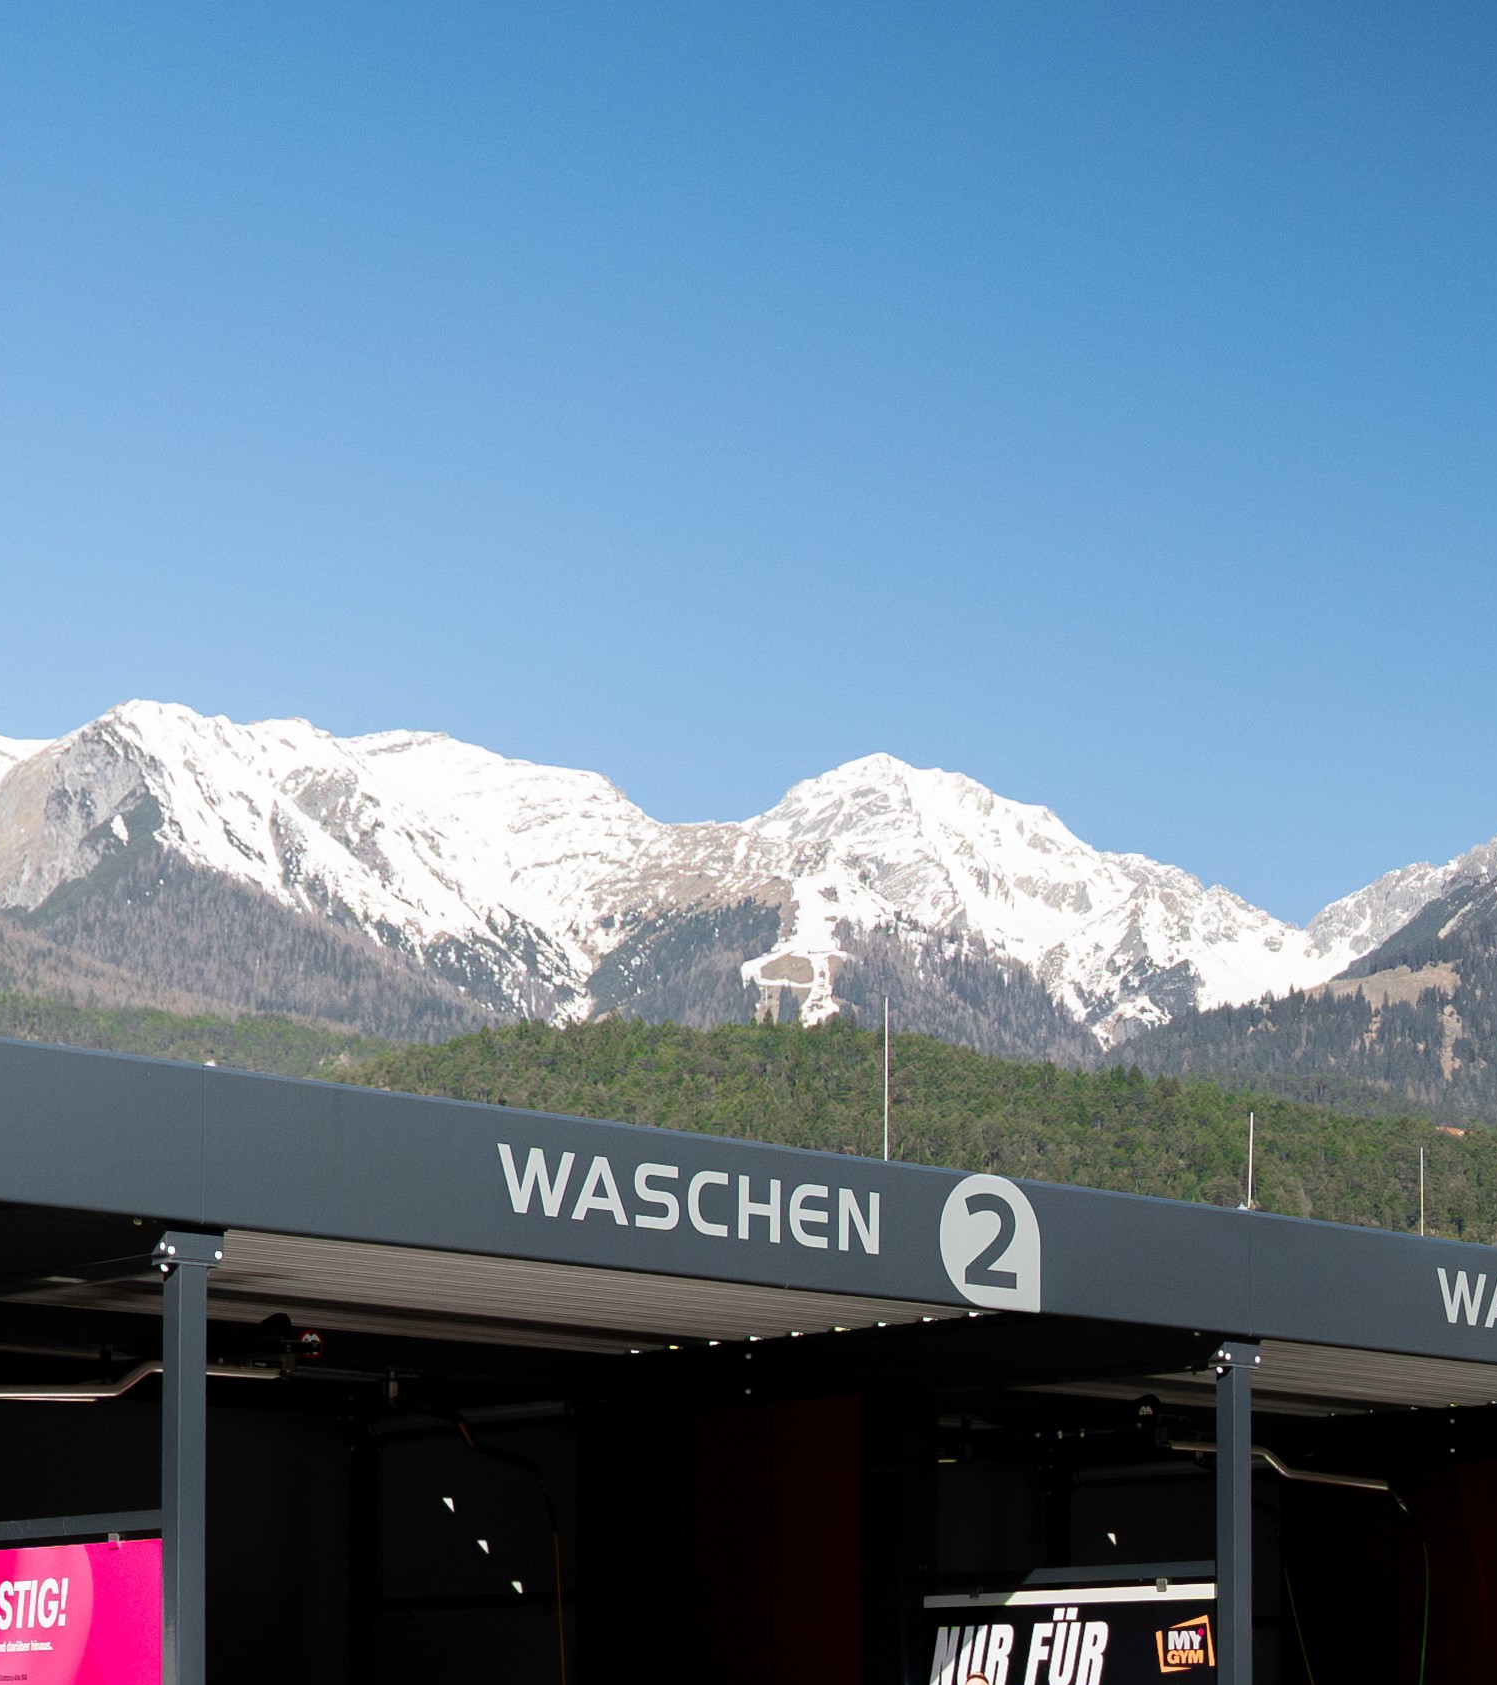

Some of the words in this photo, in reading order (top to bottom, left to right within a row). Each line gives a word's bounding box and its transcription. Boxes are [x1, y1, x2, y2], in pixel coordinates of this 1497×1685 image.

[497, 1143, 880, 1255] WASCHEN
[964, 1192, 1017, 1290] 2
[7, 1640, 30, 1652] darüber
[1168, 1630, 1202, 1650] MY
[1166, 1649, 1204, 1664] GYM
